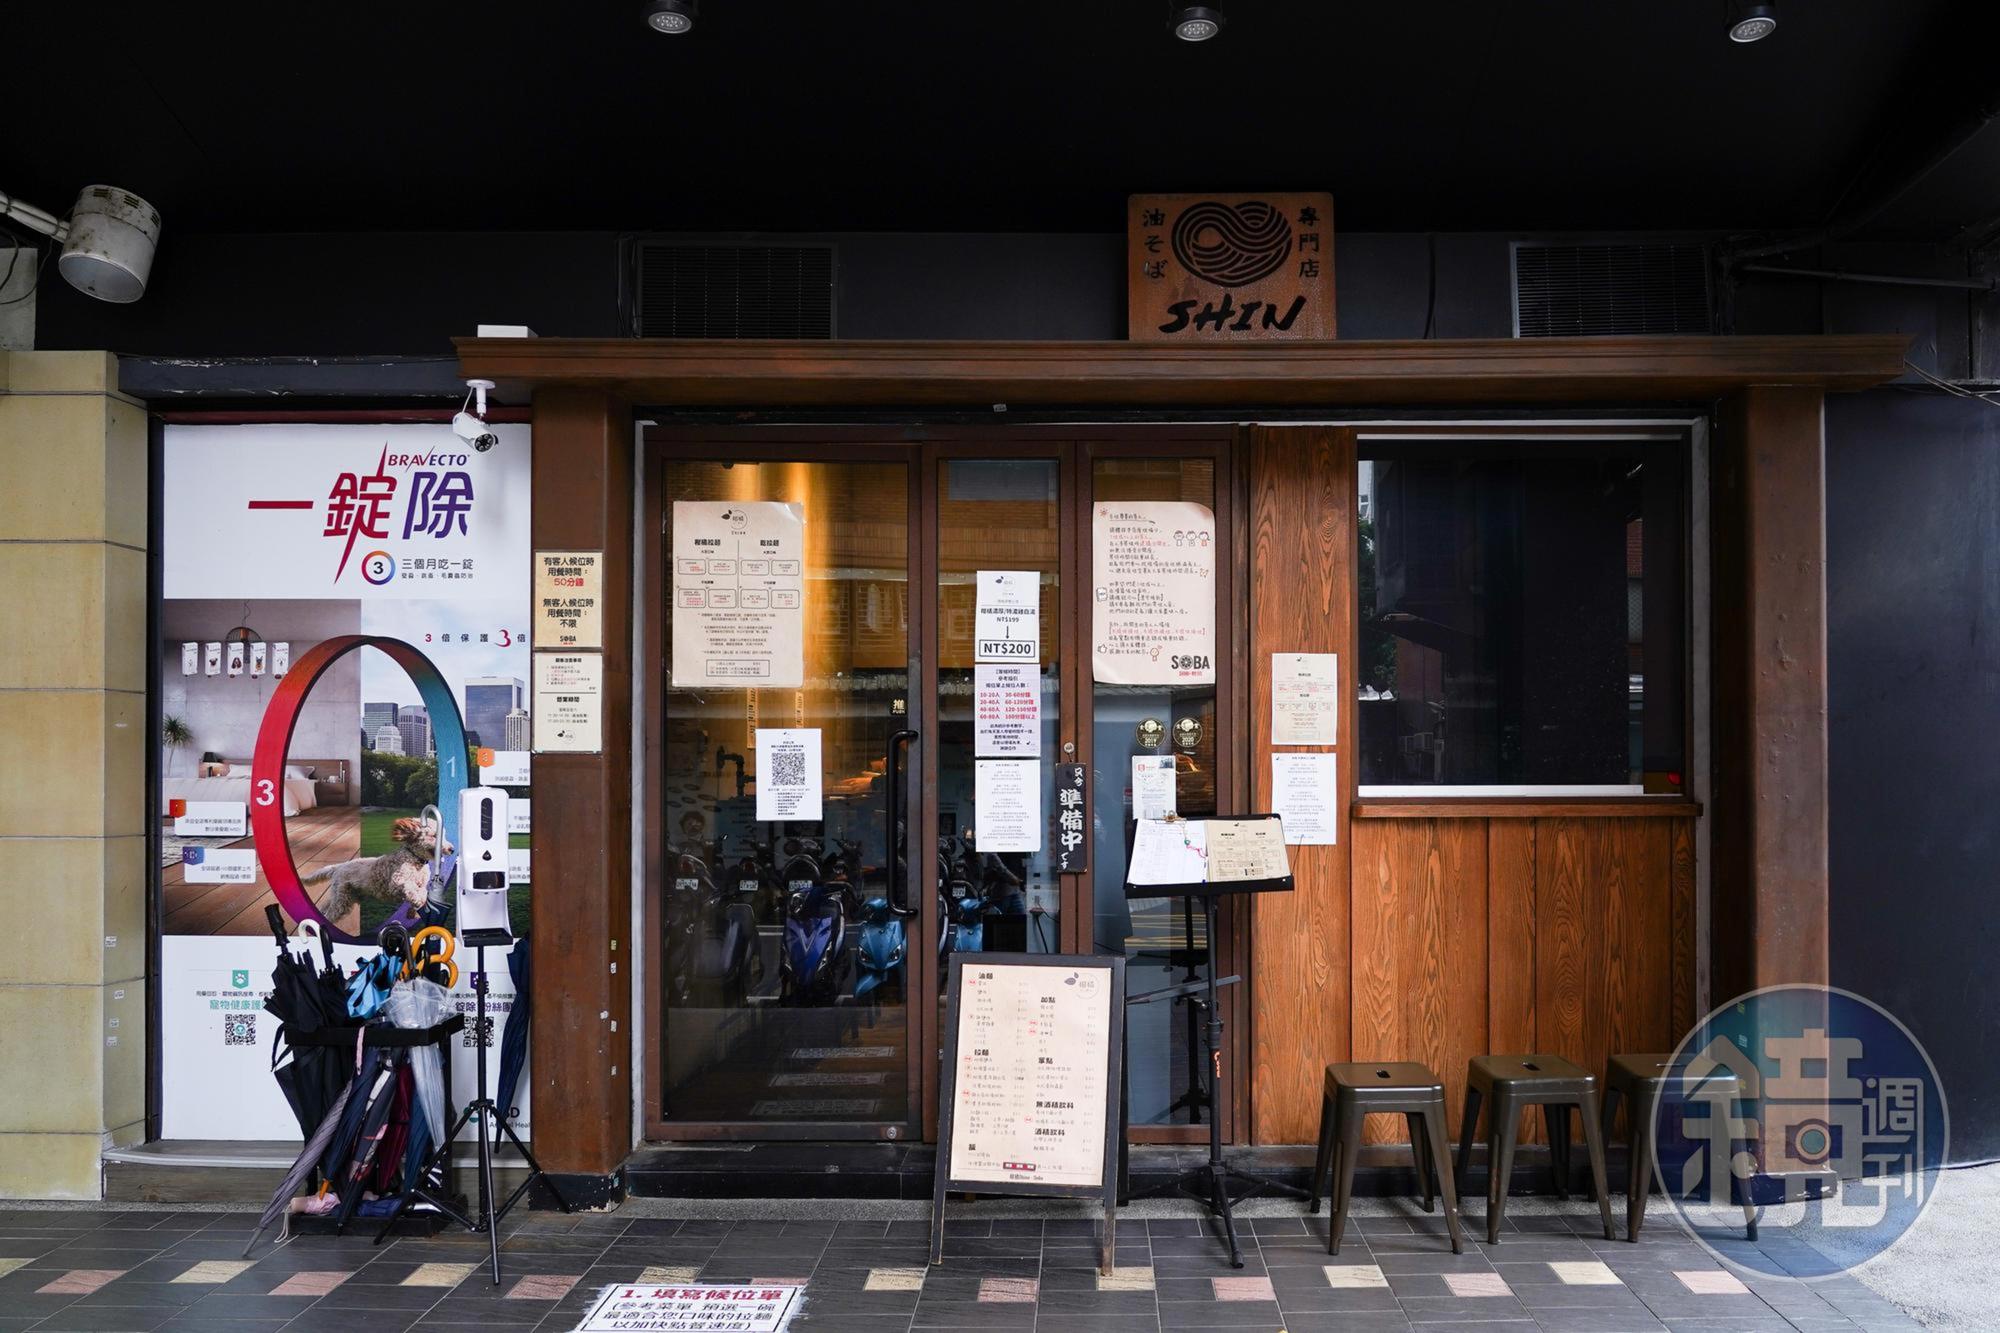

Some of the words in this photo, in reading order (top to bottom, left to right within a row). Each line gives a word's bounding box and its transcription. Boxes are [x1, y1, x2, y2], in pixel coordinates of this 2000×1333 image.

[1143, 207, 1167, 279] 油そば
[1158, 292, 1307, 334] SHIN
[388, 450, 468, 468] BRAVECTO
[373, 561, 384, 575] 3
[402, 558, 474, 570] 三個月吃一錠
[544, 557, 595, 566] 有客人候位時
[554, 577, 584, 587] 50分鐘
[543, 598, 594, 608] 無客人候位時
[560, 618, 578, 628] 不限
[984, 643, 1032, 655] NT$200
[1171, 655, 1210, 670] SOBA
[256, 779, 276, 806] 3
[1059, 788, 1084, 852] 準備中
[210, 999, 268, 1010] 寵物健康護
[652, 1289, 784, 1300] 填寫候位單
[603, 1312, 772, 1320] 最適合您口味的拉麵
